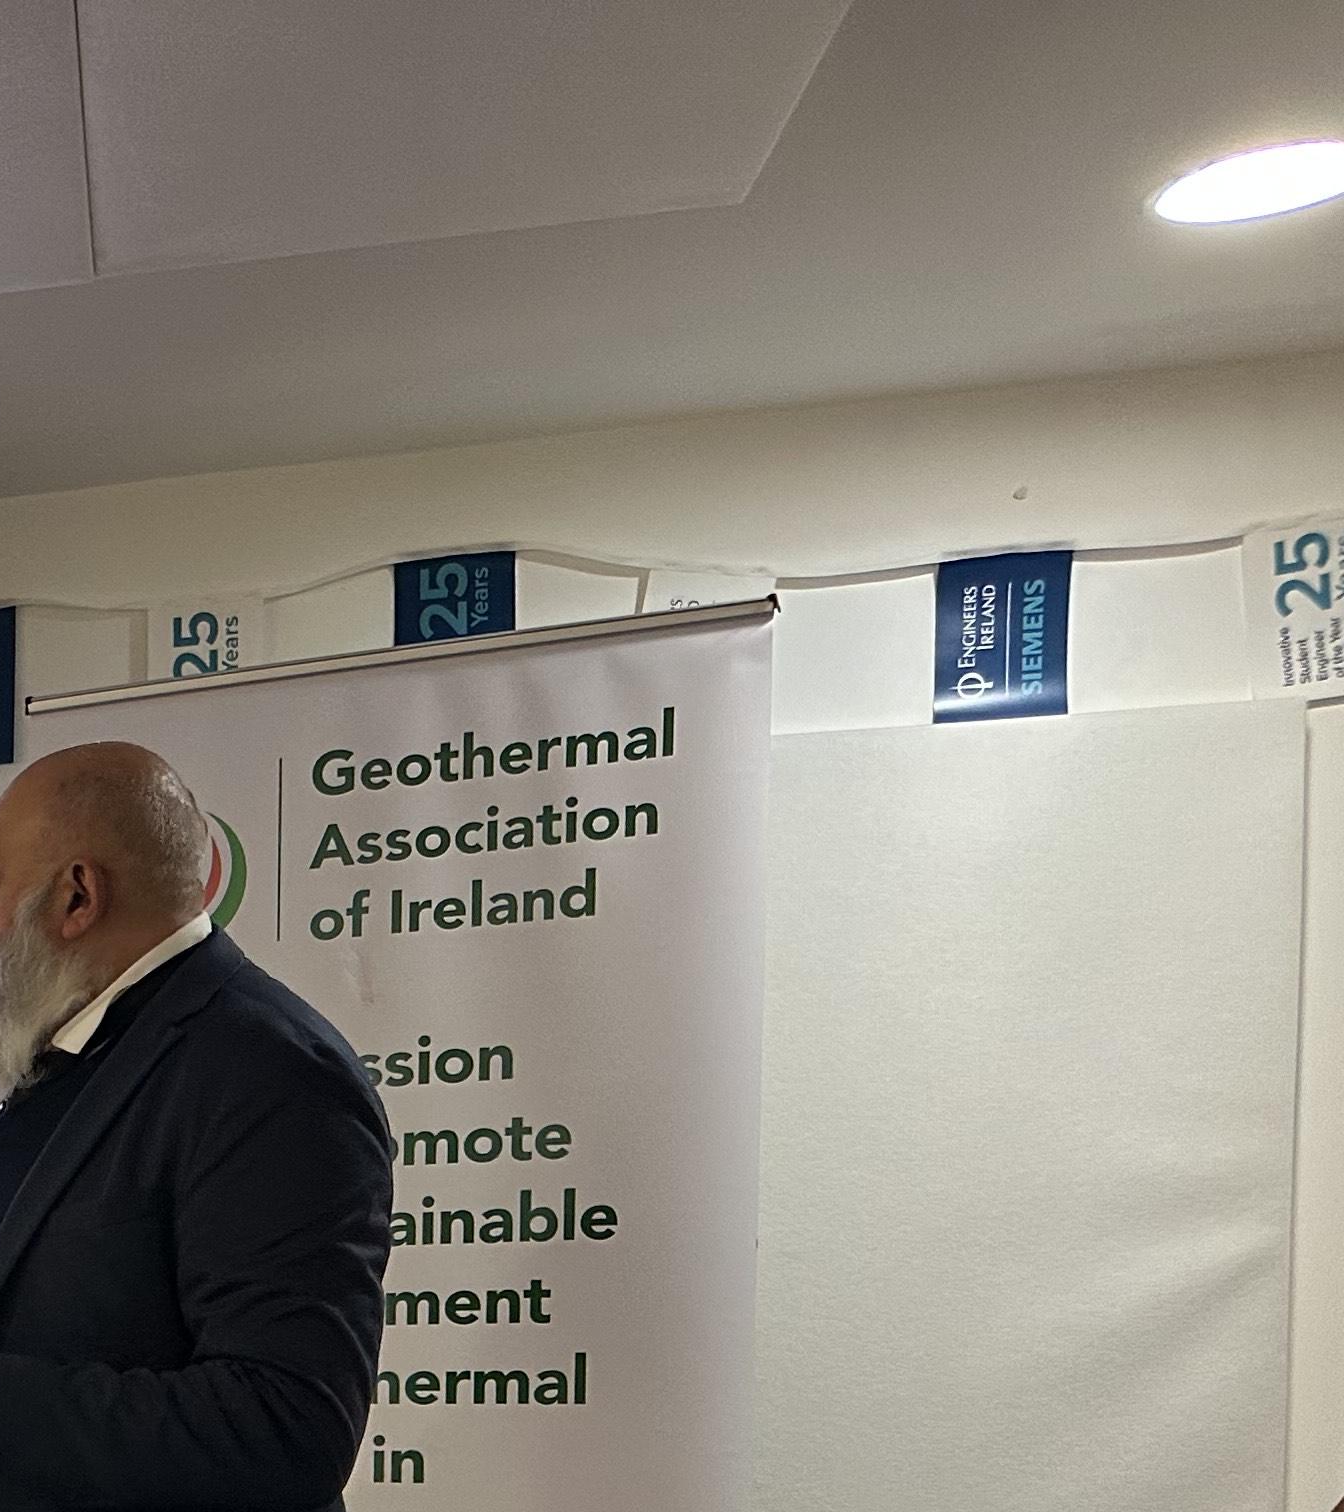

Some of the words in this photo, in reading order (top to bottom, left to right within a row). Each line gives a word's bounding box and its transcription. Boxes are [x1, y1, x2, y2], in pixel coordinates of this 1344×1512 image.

[419, 562, 468, 639] 25
[470, 567, 489, 628] Years
[1274, 533, 1332, 618] 25
[173, 612, 219, 678] 25
[222, 616, 239, 671] Years
[957, 586, 978, 668] ENGINEERS
[976, 584, 996, 651] IRELAND
[1021, 579, 1046, 695] SIEMENS
[312, 706, 675, 796] Geothermal
[310, 796, 659, 870] Association
[310, 889, 371, 942] of
[391, 867, 597, 935] Ireland
[391, 1117, 572, 1166] mote
[385, 1279, 552, 1326] ment
[373, 1435, 425, 1484] in
